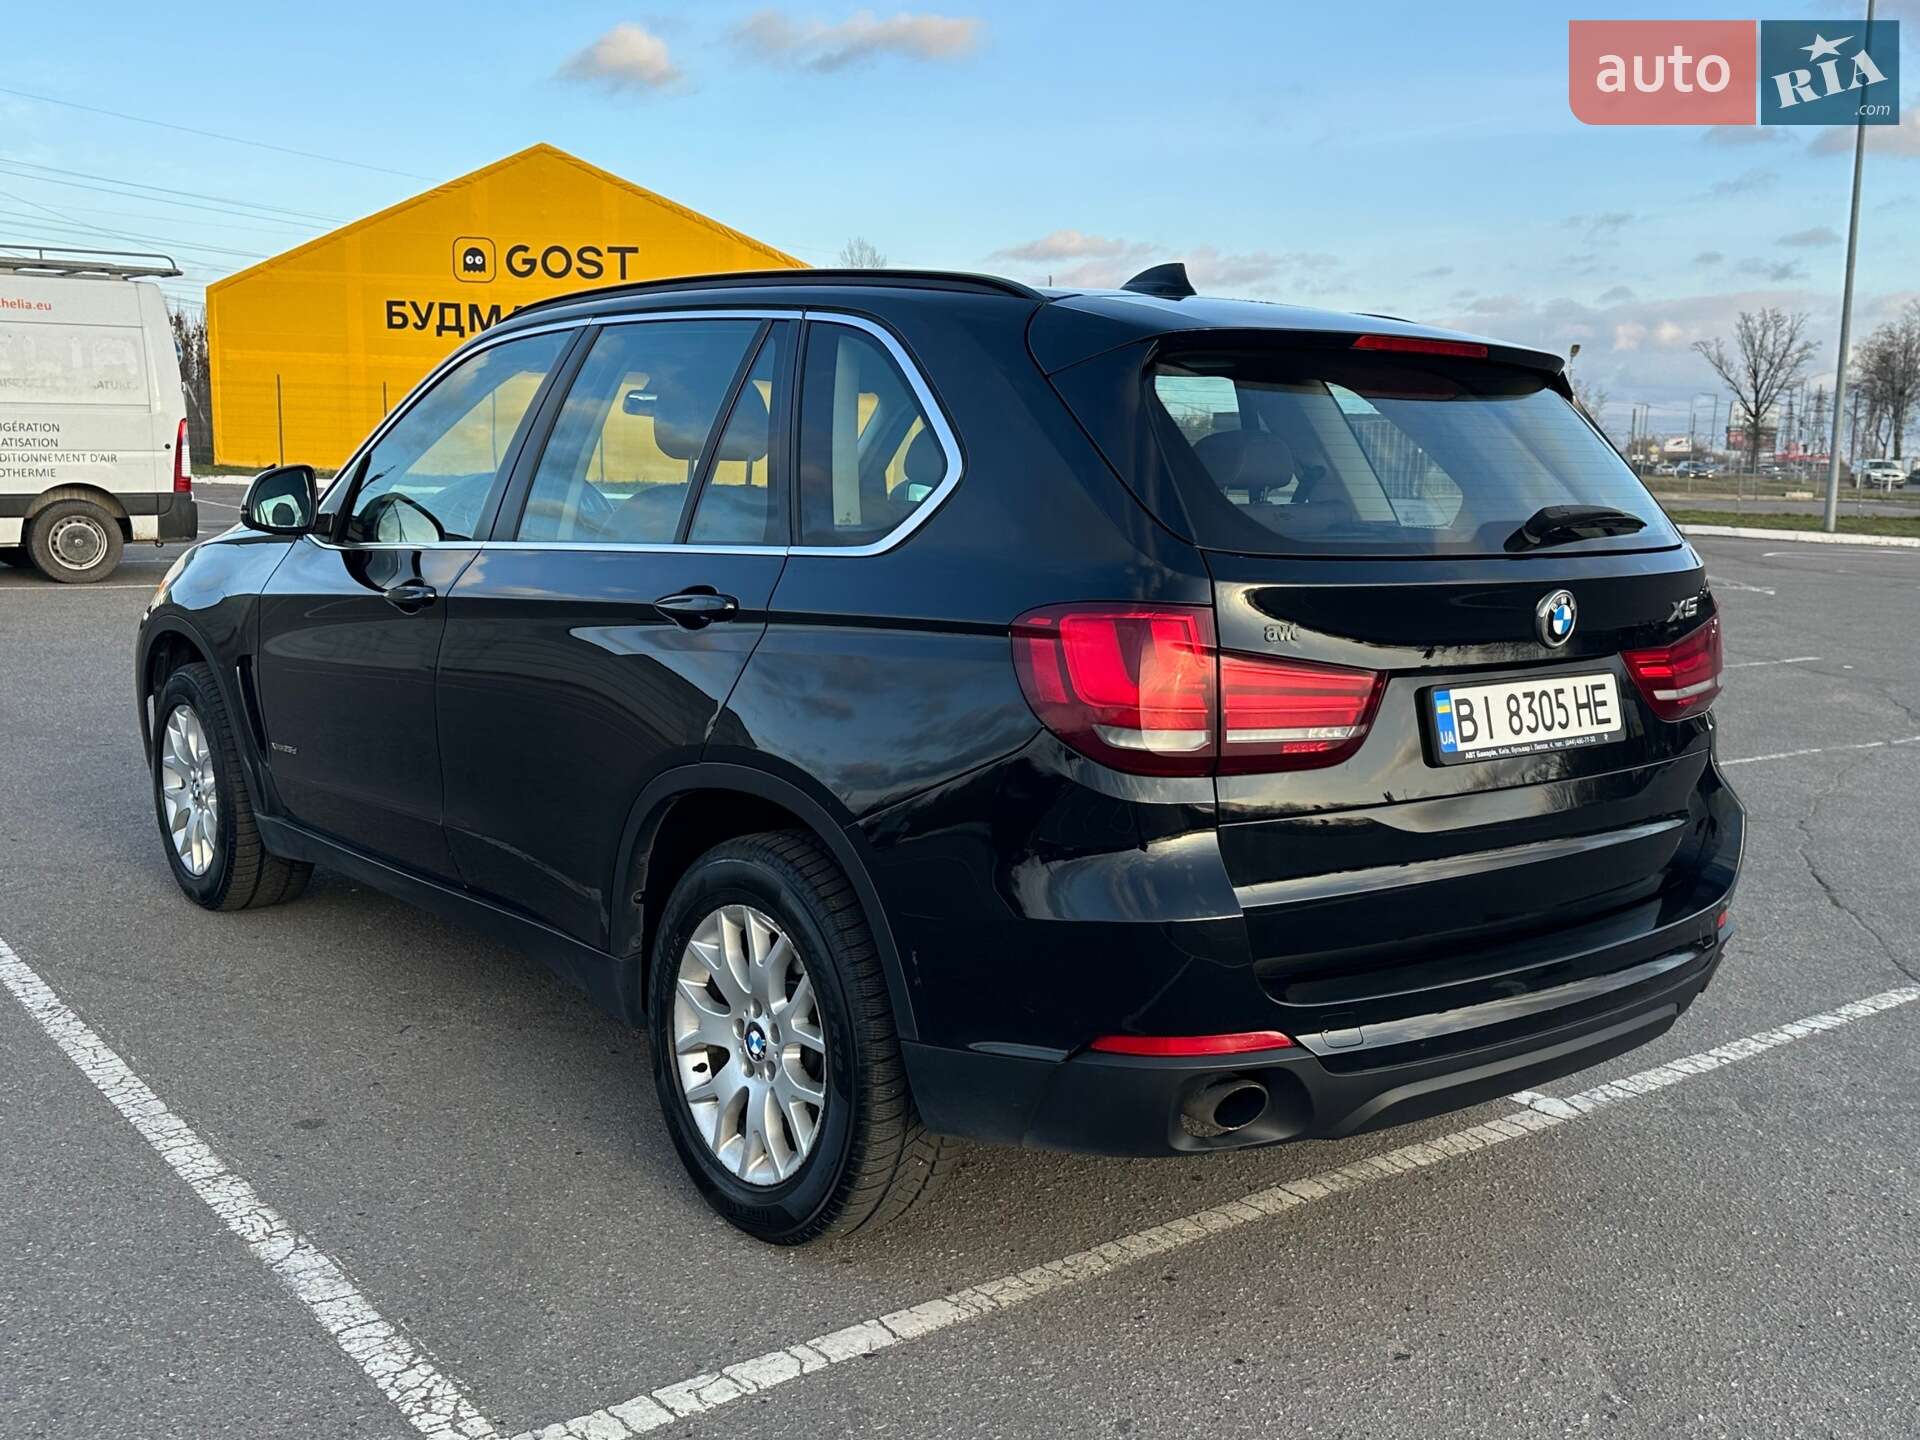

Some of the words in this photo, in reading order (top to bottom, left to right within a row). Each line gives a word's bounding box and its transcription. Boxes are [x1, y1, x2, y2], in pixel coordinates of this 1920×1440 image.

[505, 244, 640, 281] GOST
[0, 298, 52, 311] helia.eu
[386, 300, 522, 338] БУДМ
[1, 437, 59, 448] ATISATION
[90, 453, 118, 464] D'AIR
[1666, 596, 1698, 623] X5
[1454, 695, 1495, 744] BI
[1506, 687, 1570, 736] 8305
[1572, 683, 1612, 728] HE
[1440, 730, 1456, 745] UA
